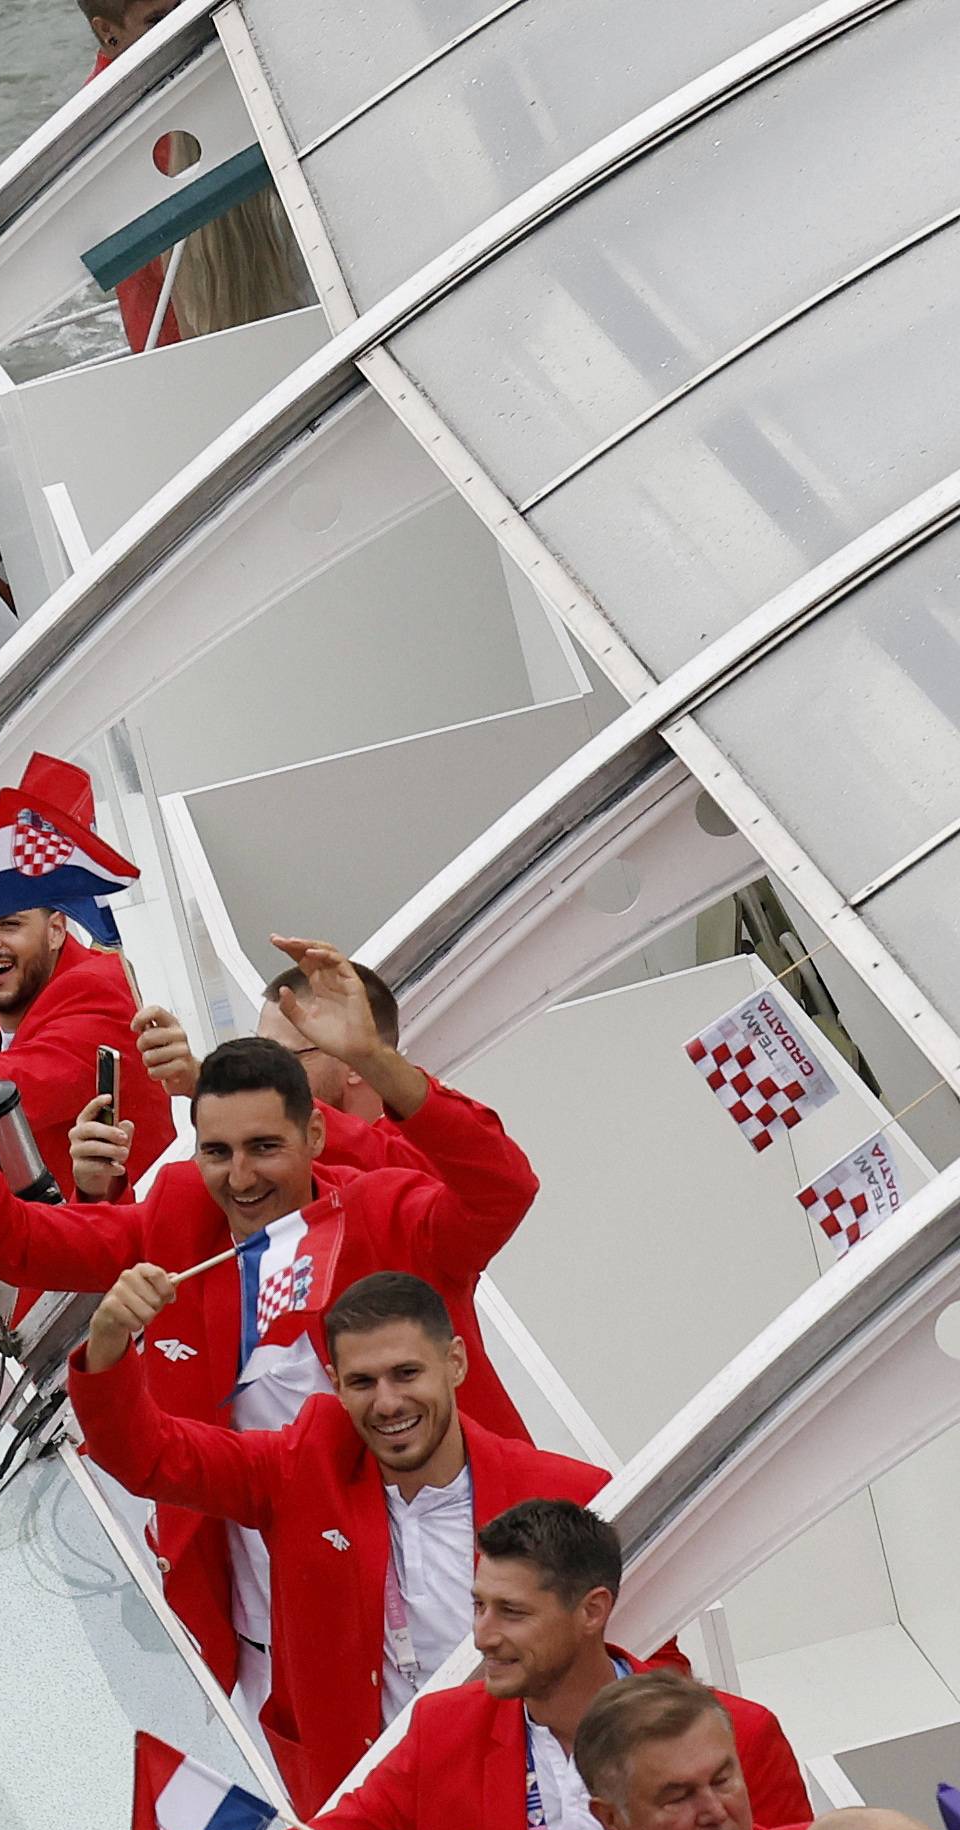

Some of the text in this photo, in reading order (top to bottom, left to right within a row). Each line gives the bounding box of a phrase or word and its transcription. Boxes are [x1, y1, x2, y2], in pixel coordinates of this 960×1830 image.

[740, 1010, 778, 1061] TEAM
[756, 998, 815, 1077] CROATIA
[852, 1155, 885, 1215] TEAM
[154, 1338, 198, 1362] 4F
[321, 1529, 351, 1551] 4F
